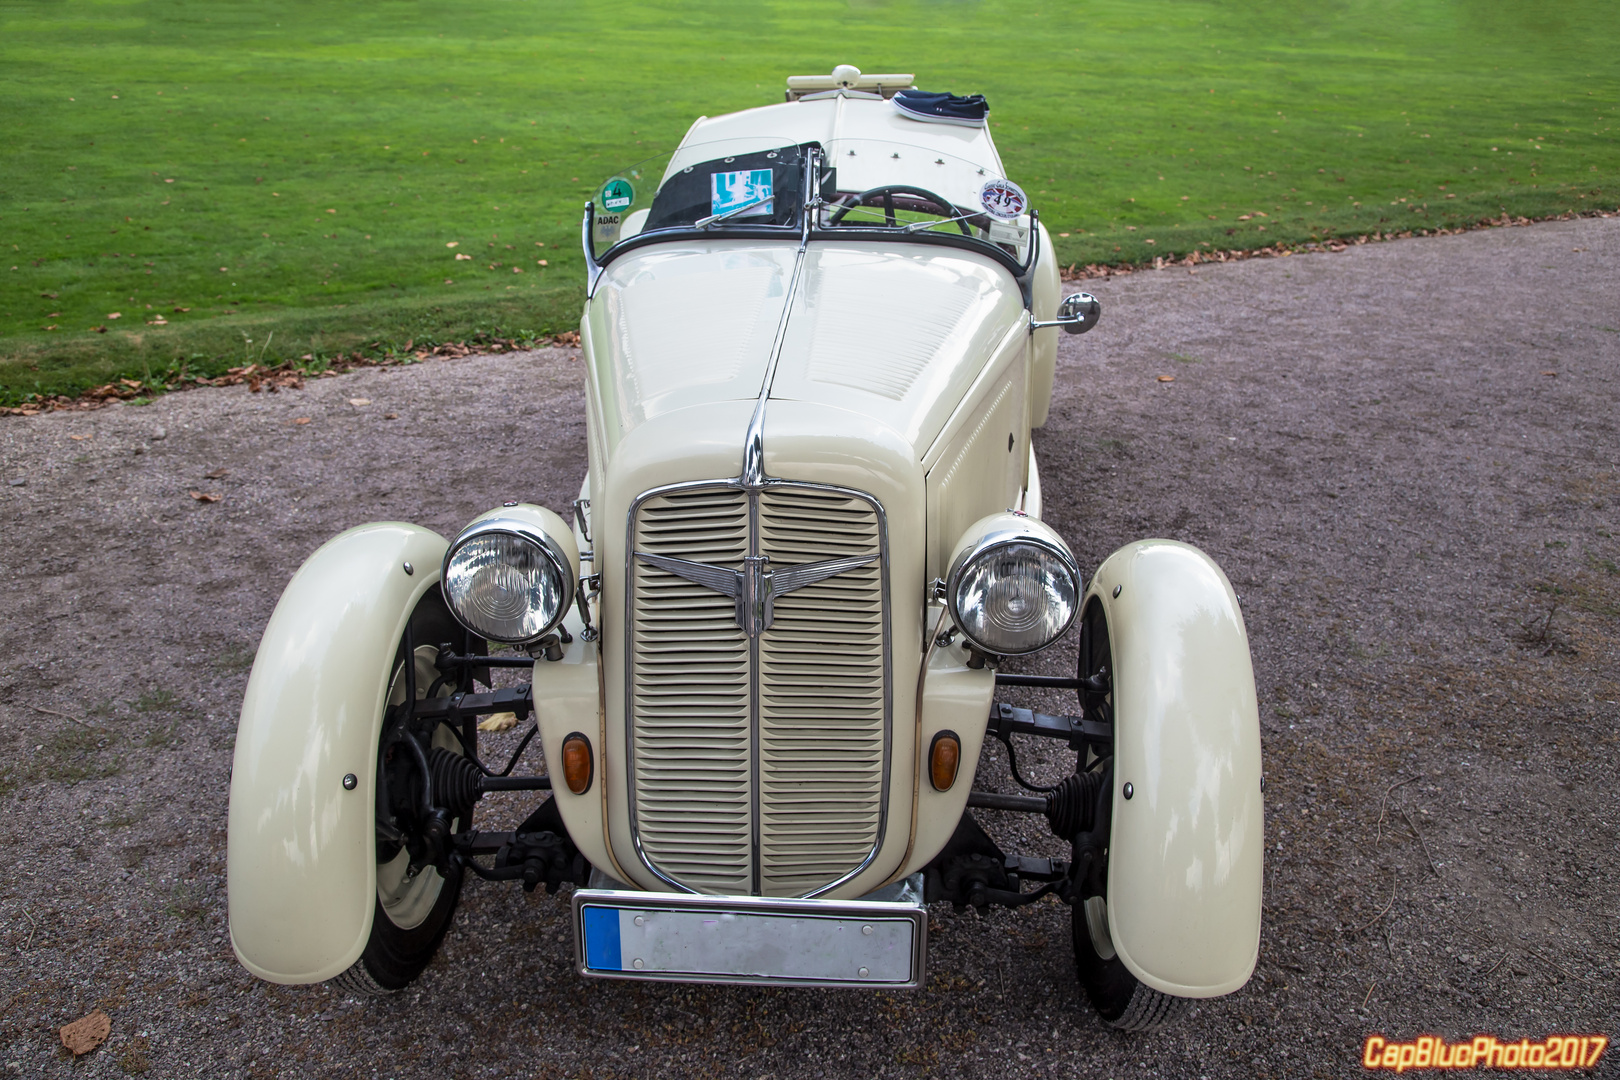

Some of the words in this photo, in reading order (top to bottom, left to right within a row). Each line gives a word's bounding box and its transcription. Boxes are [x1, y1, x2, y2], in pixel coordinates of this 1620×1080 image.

[613, 182, 621, 196] 4
[994, 194, 1011, 207] 49
[598, 216, 619, 225] ADAC
